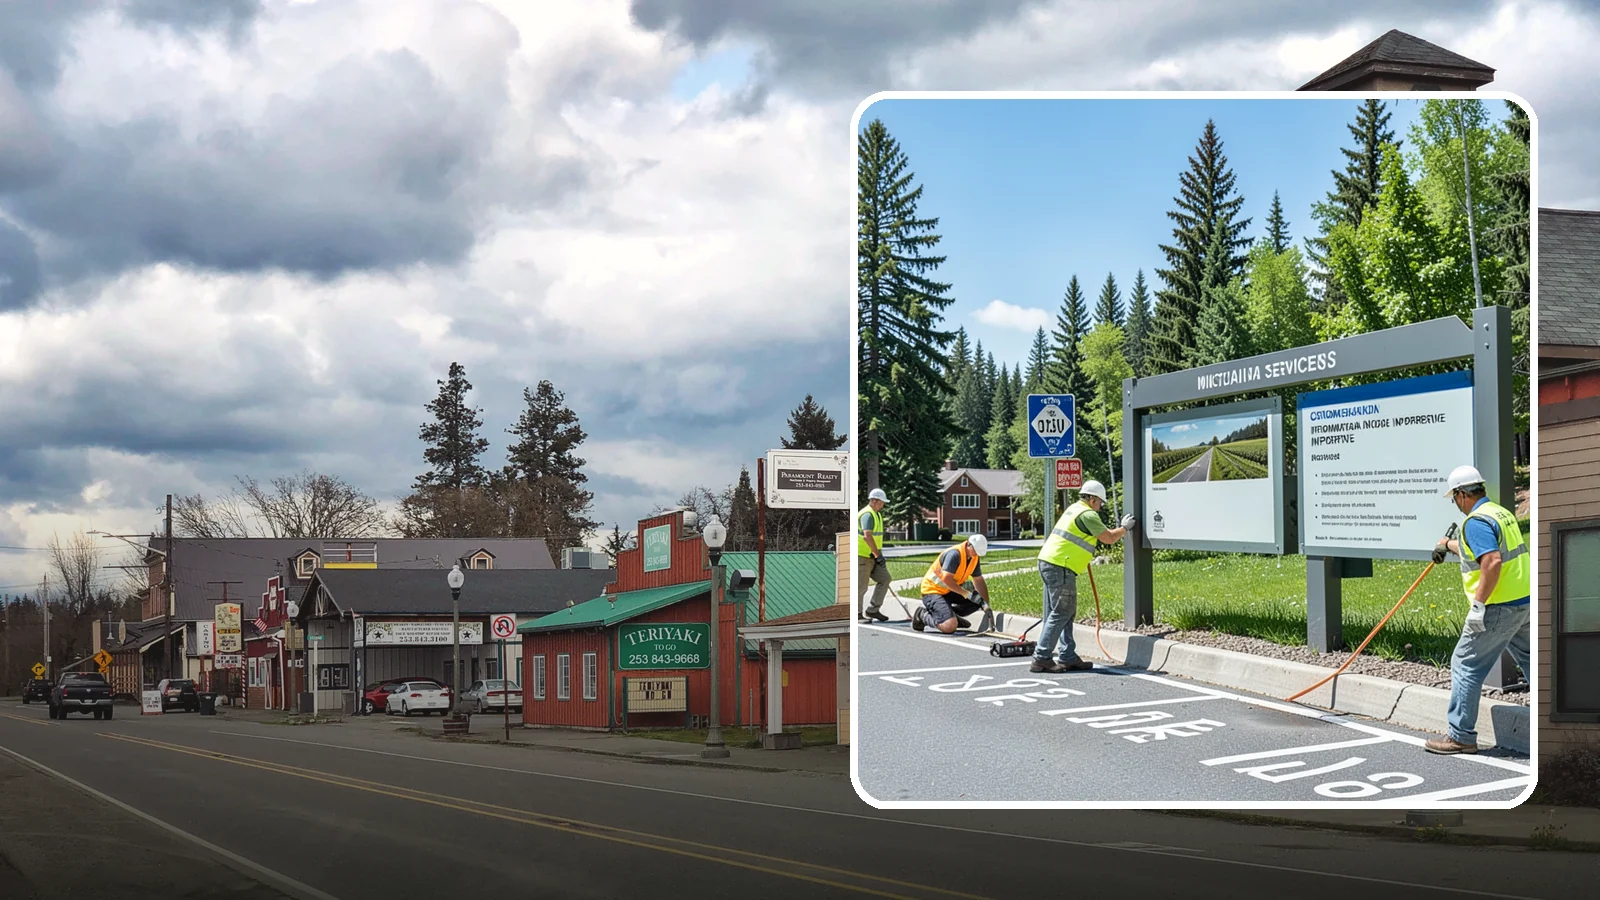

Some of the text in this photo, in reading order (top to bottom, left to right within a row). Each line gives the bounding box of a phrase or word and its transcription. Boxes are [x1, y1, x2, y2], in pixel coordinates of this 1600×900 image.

[817, 472, 839, 480] REALTY
[625, 627, 702, 646] TERIYAKI
[629, 654, 700, 664] 253 843-9668
